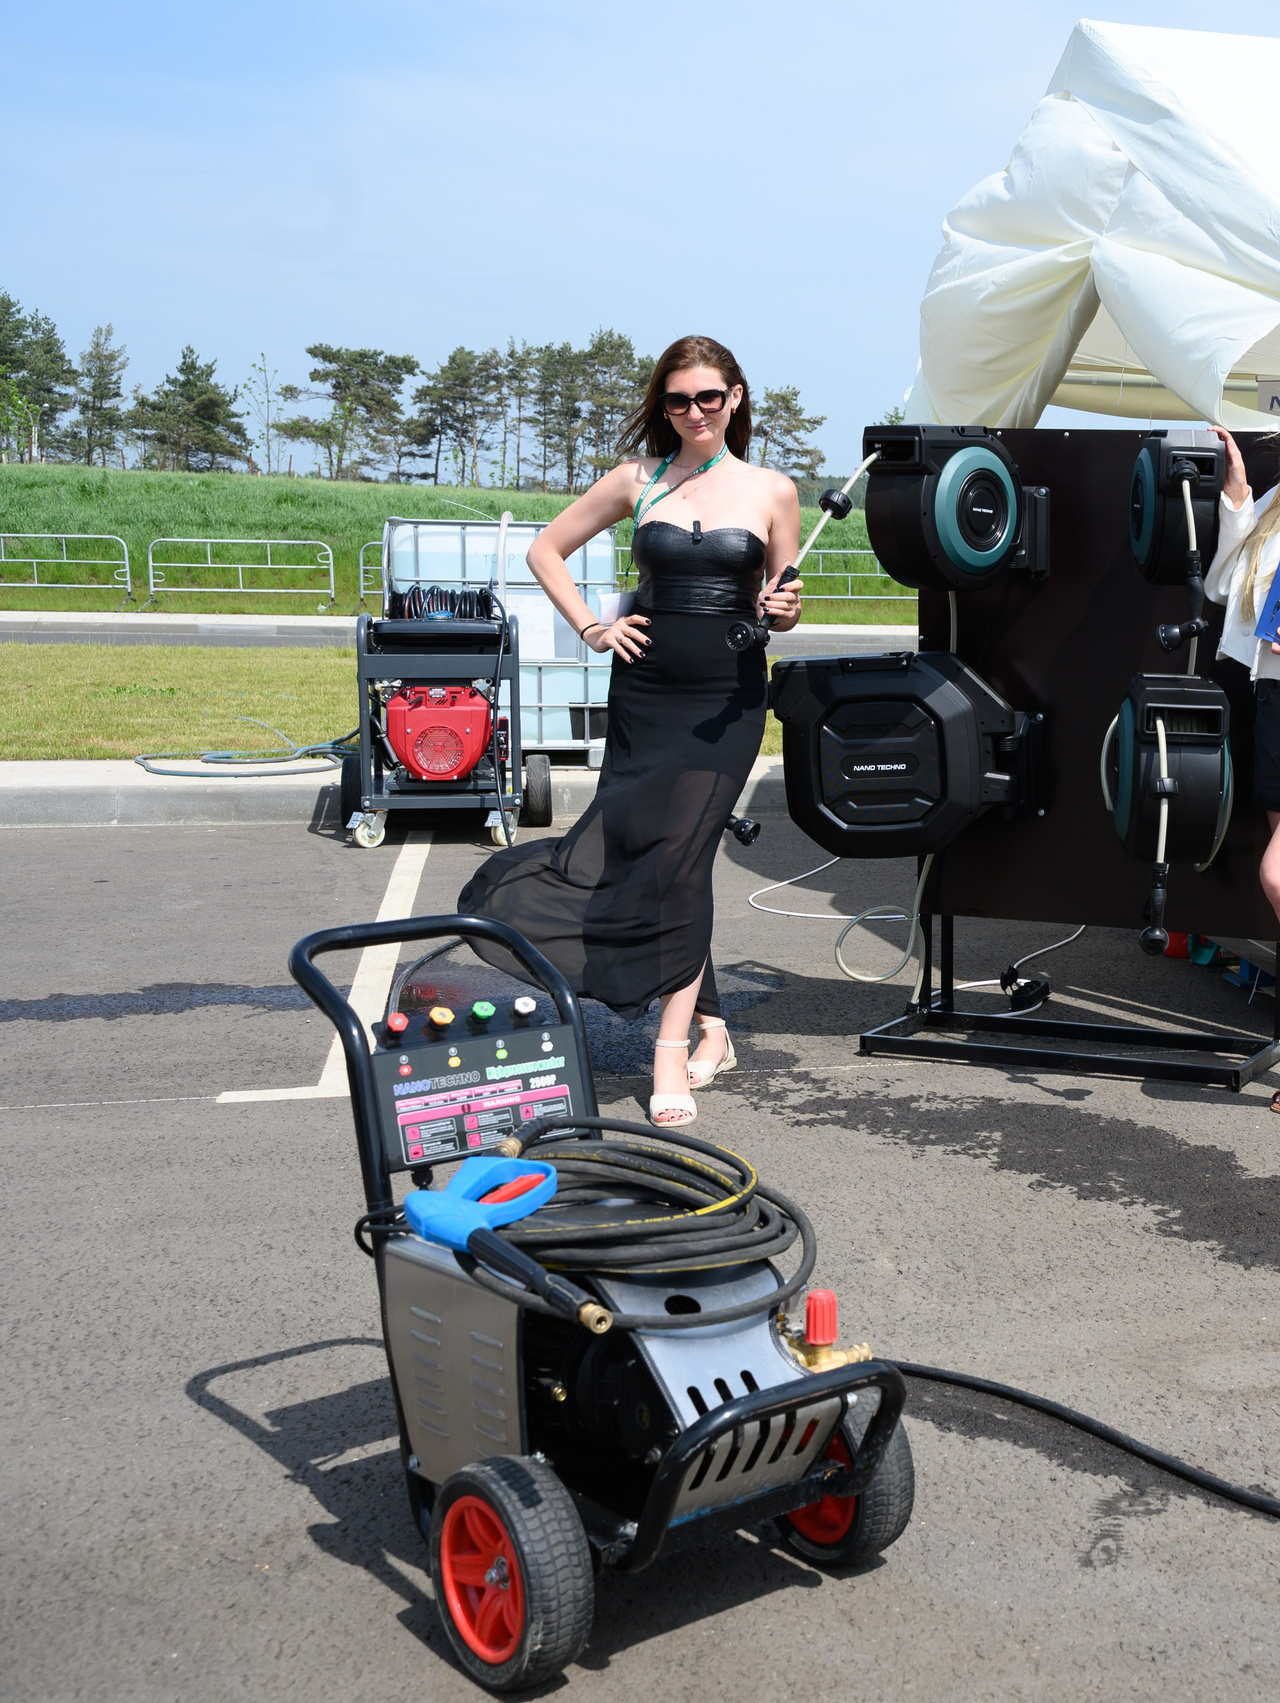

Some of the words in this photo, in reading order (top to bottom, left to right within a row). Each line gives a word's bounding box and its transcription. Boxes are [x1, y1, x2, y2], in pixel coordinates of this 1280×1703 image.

[876, 763, 907, 771] TECHNO
[393, 1070, 480, 1096] NANOTECHNO
[483, 1096, 521, 1108] WARNING
